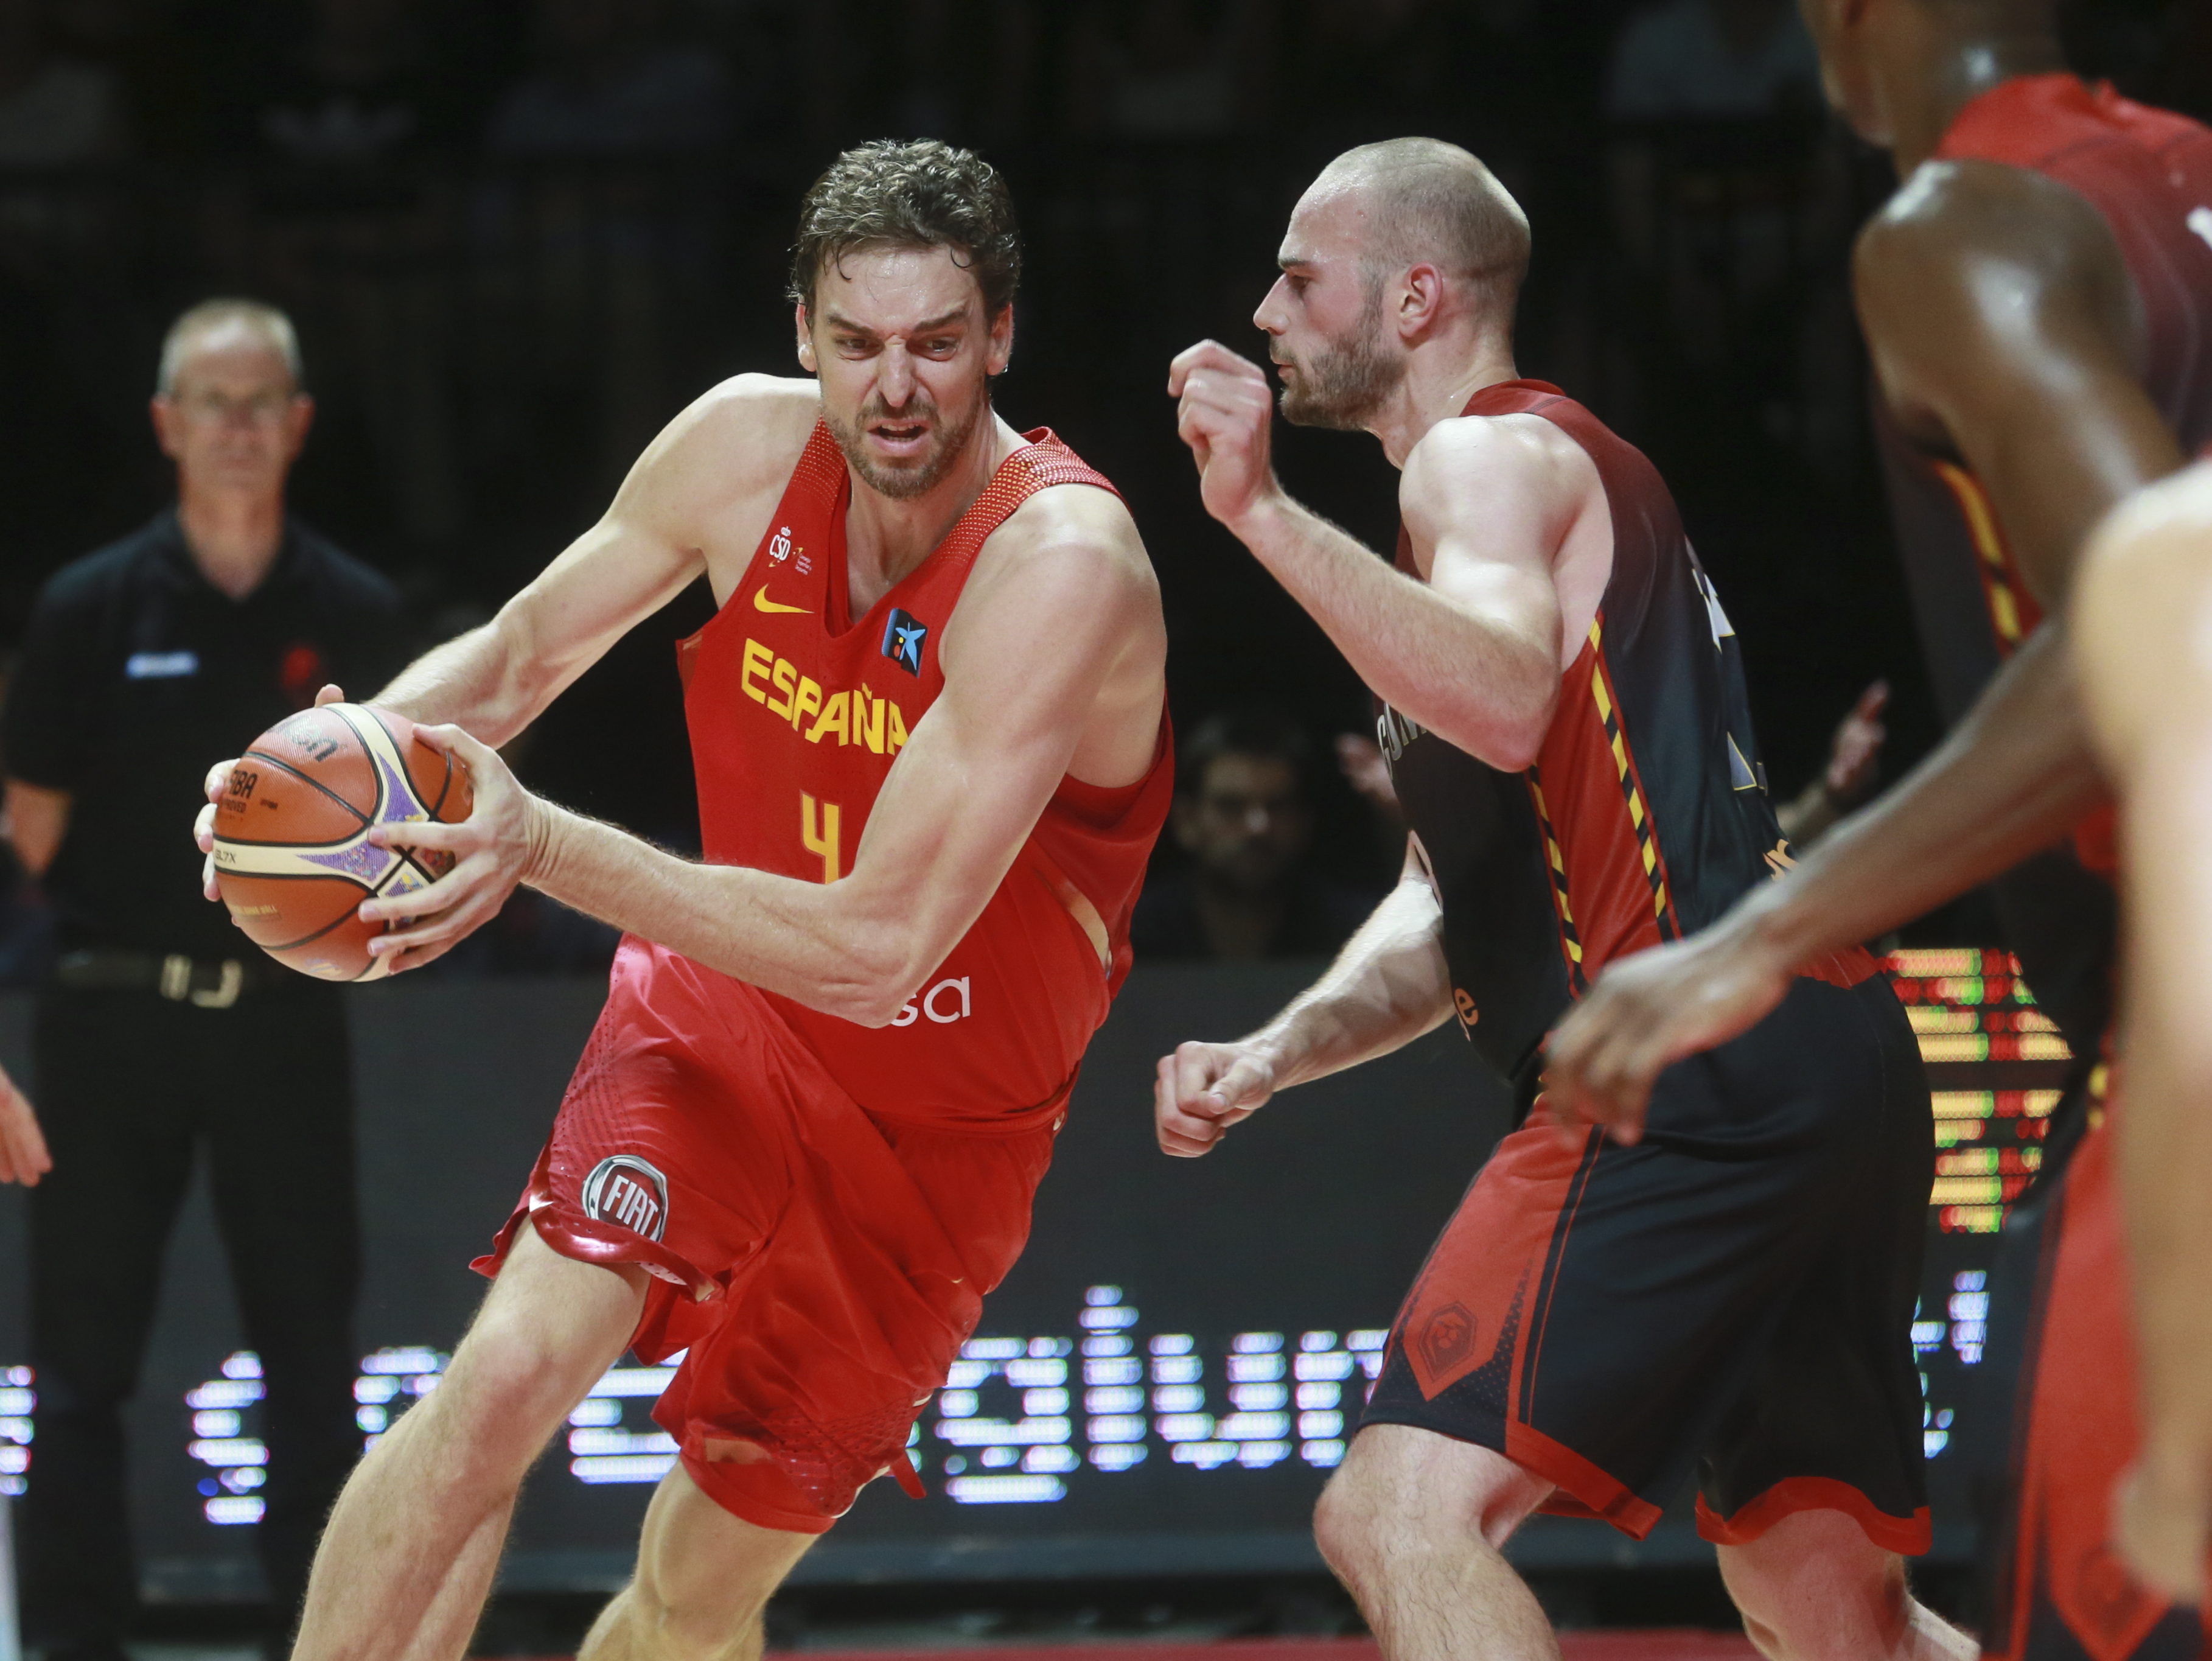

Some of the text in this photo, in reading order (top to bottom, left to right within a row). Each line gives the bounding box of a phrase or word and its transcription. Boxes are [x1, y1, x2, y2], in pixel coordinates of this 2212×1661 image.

[769, 534, 790, 561] CSD
[741, 637, 909, 756] ESPAÑA
[800, 789, 841, 885] 4
[890, 976, 971, 1027] sa
[602, 1174, 658, 1236] FIAT
